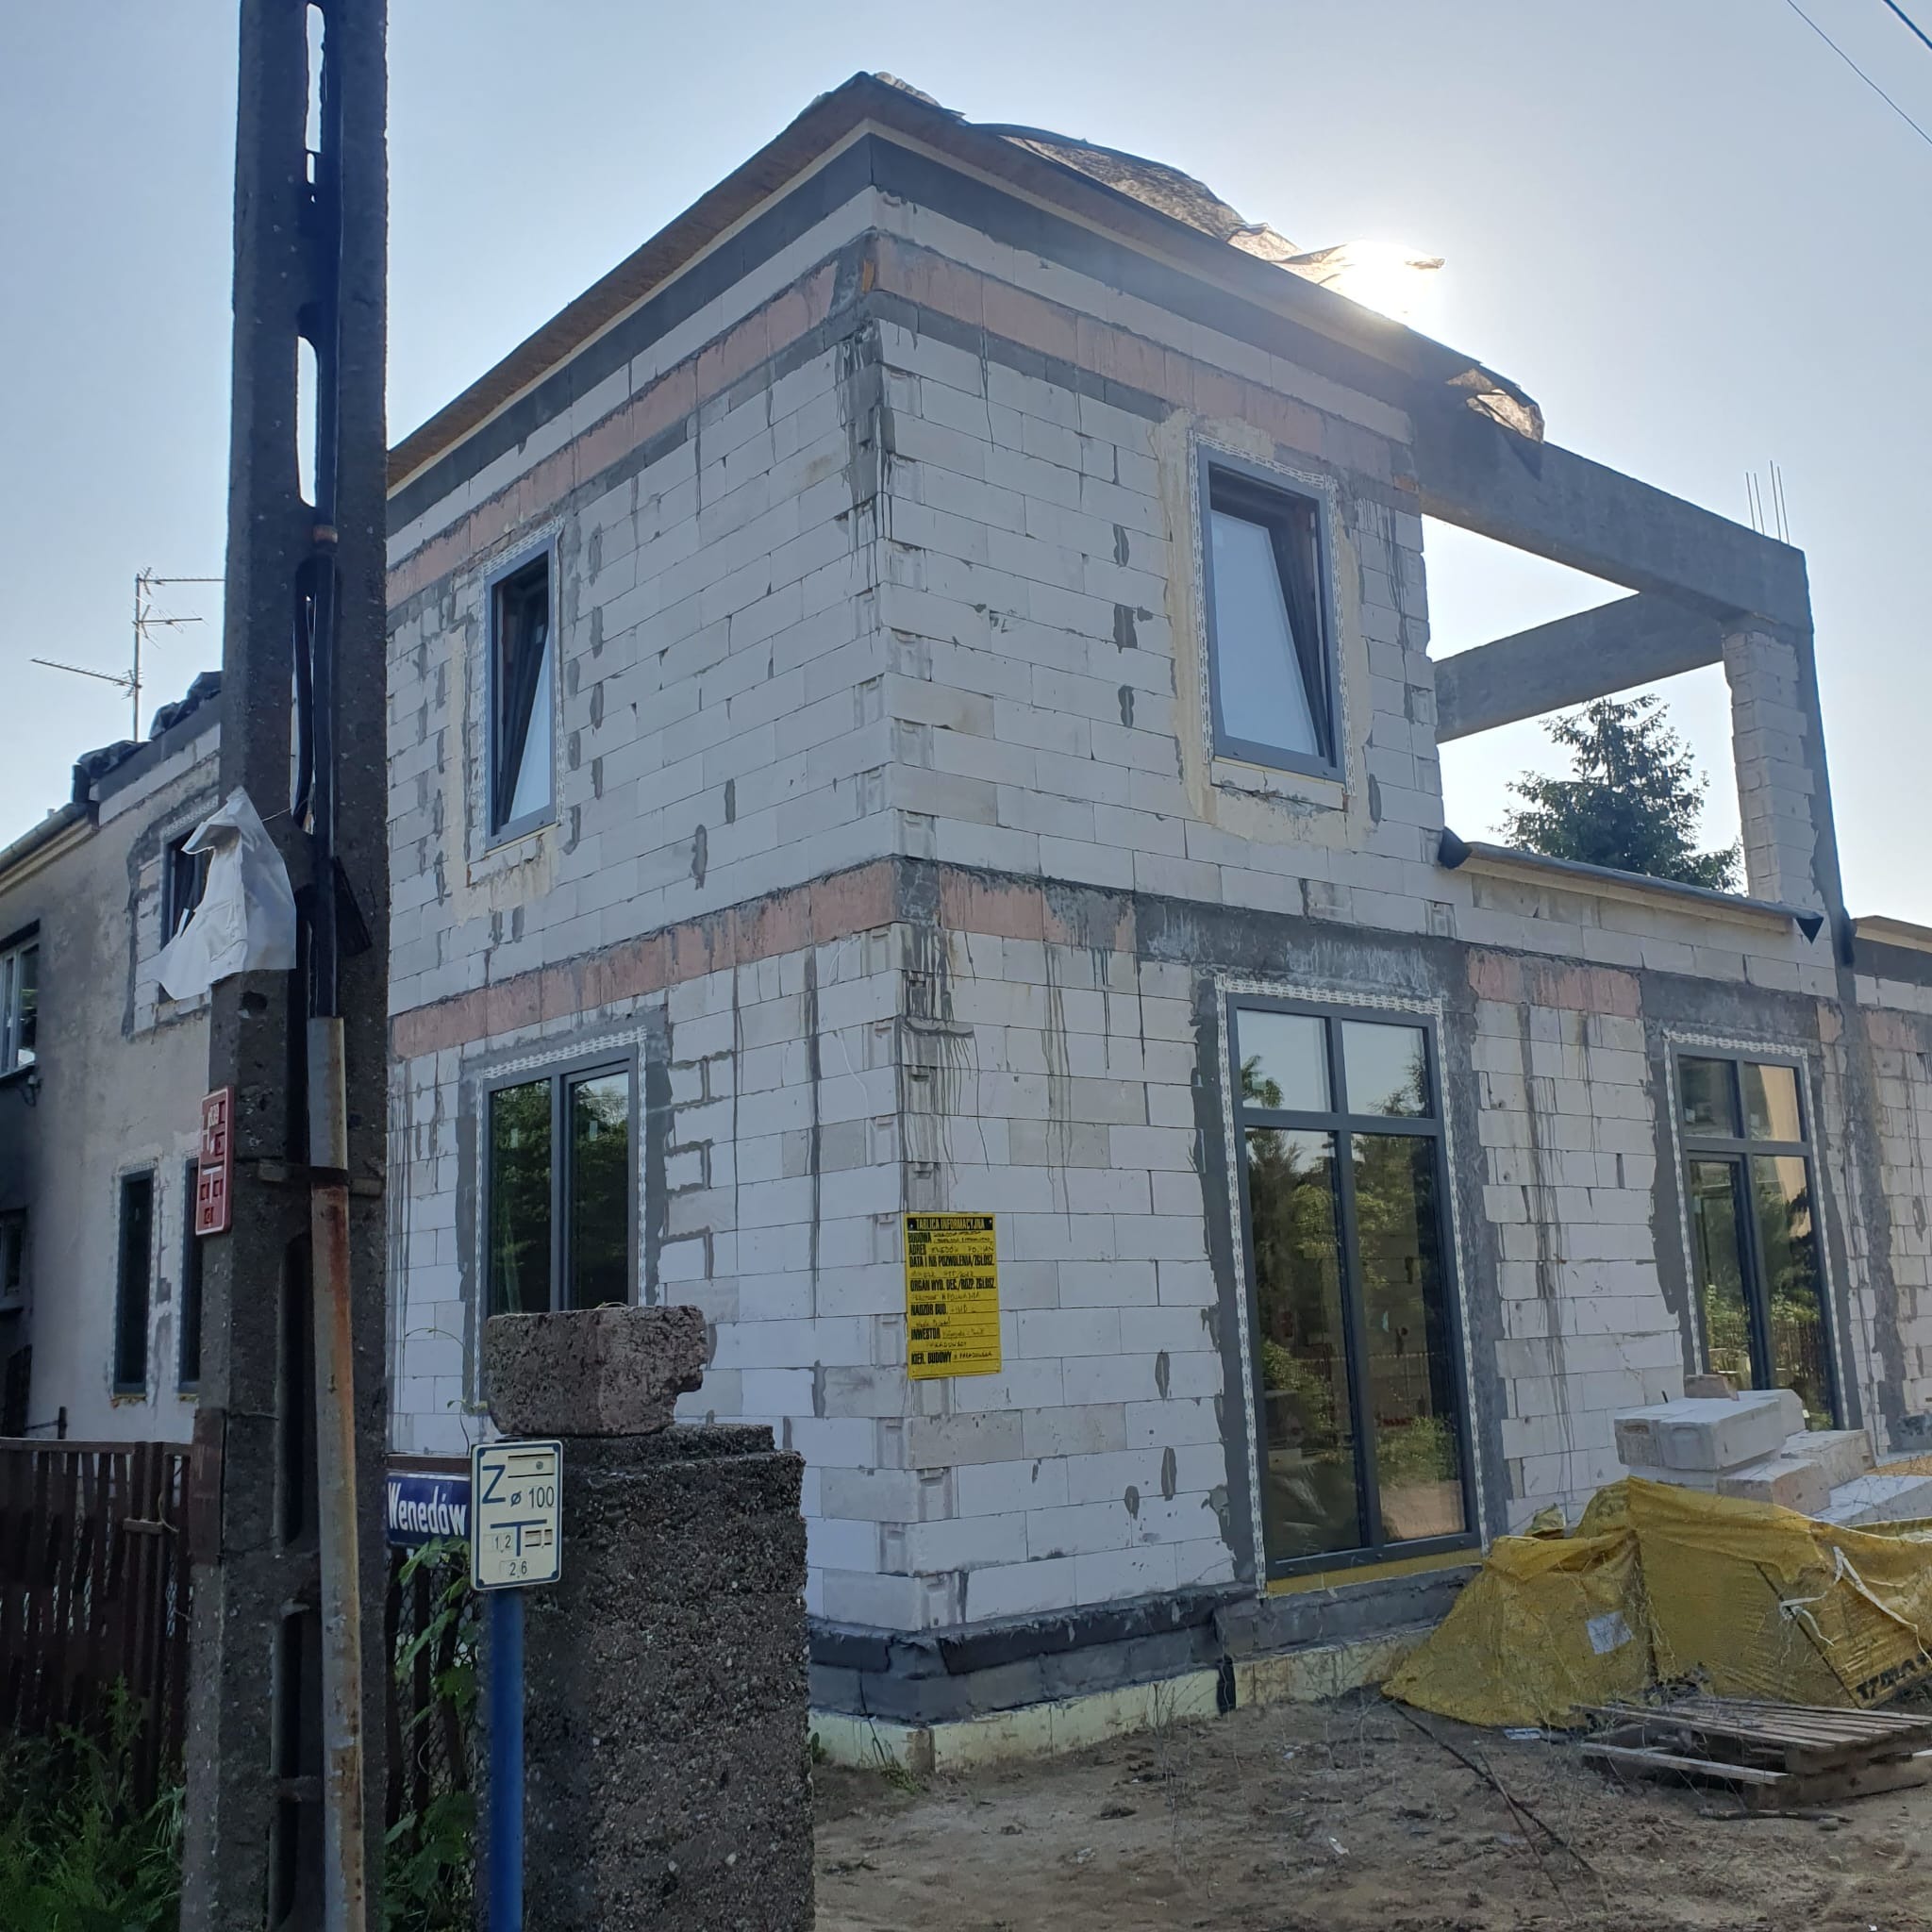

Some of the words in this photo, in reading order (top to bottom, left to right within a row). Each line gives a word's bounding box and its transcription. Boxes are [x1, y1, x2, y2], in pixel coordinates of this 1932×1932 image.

[482, 1464, 506, 1505] Z
[528, 1486, 555, 1508] 100
[388, 1482, 467, 1536] Wenedów
